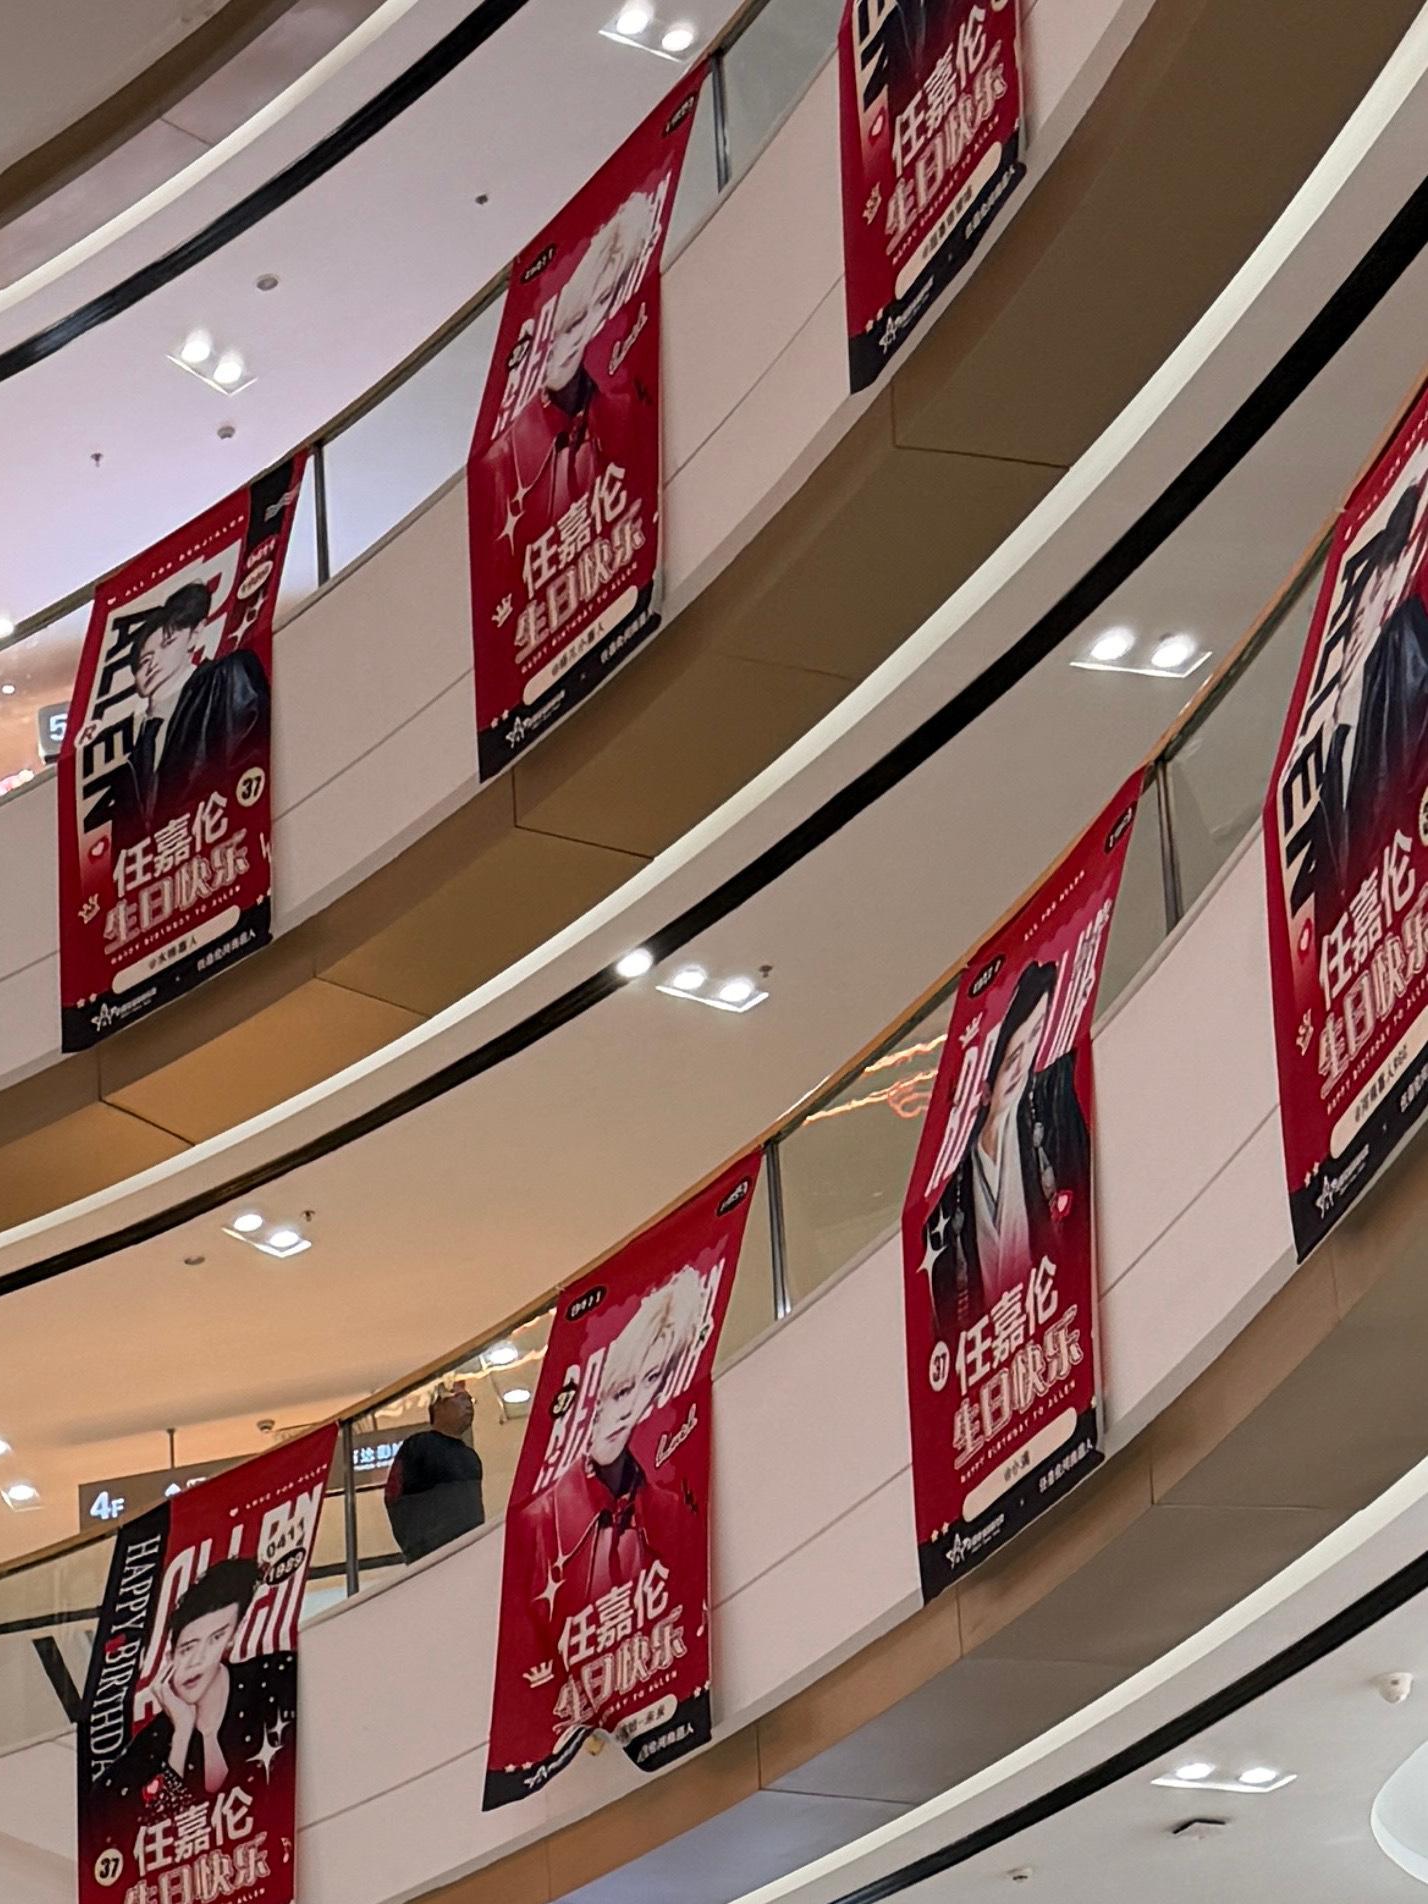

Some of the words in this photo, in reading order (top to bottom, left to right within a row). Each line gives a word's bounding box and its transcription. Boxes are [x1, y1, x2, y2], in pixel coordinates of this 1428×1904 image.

[885, 40, 1008, 255] 生日快乐
[892, 5, 986, 178] 任嘉伦
[514, 498, 645, 662] 生日快乐
[522, 461, 628, 598] 任嘉伦
[103, 824, 251, 953] 生日快乐
[112, 791, 228, 898] 任嘉伦
[1319, 830, 1415, 1011] 任嘉伦
[953, 1305, 1084, 1471] 生日快乐
[955, 1257, 1058, 1398] 任嘉伦
[90, 1491, 124, 1520] 4F
[552, 1606, 688, 1730] 生日快乐
[557, 1560, 670, 1672] 任嘉伦
[133, 1786, 254, 1877] 任嘉伦
